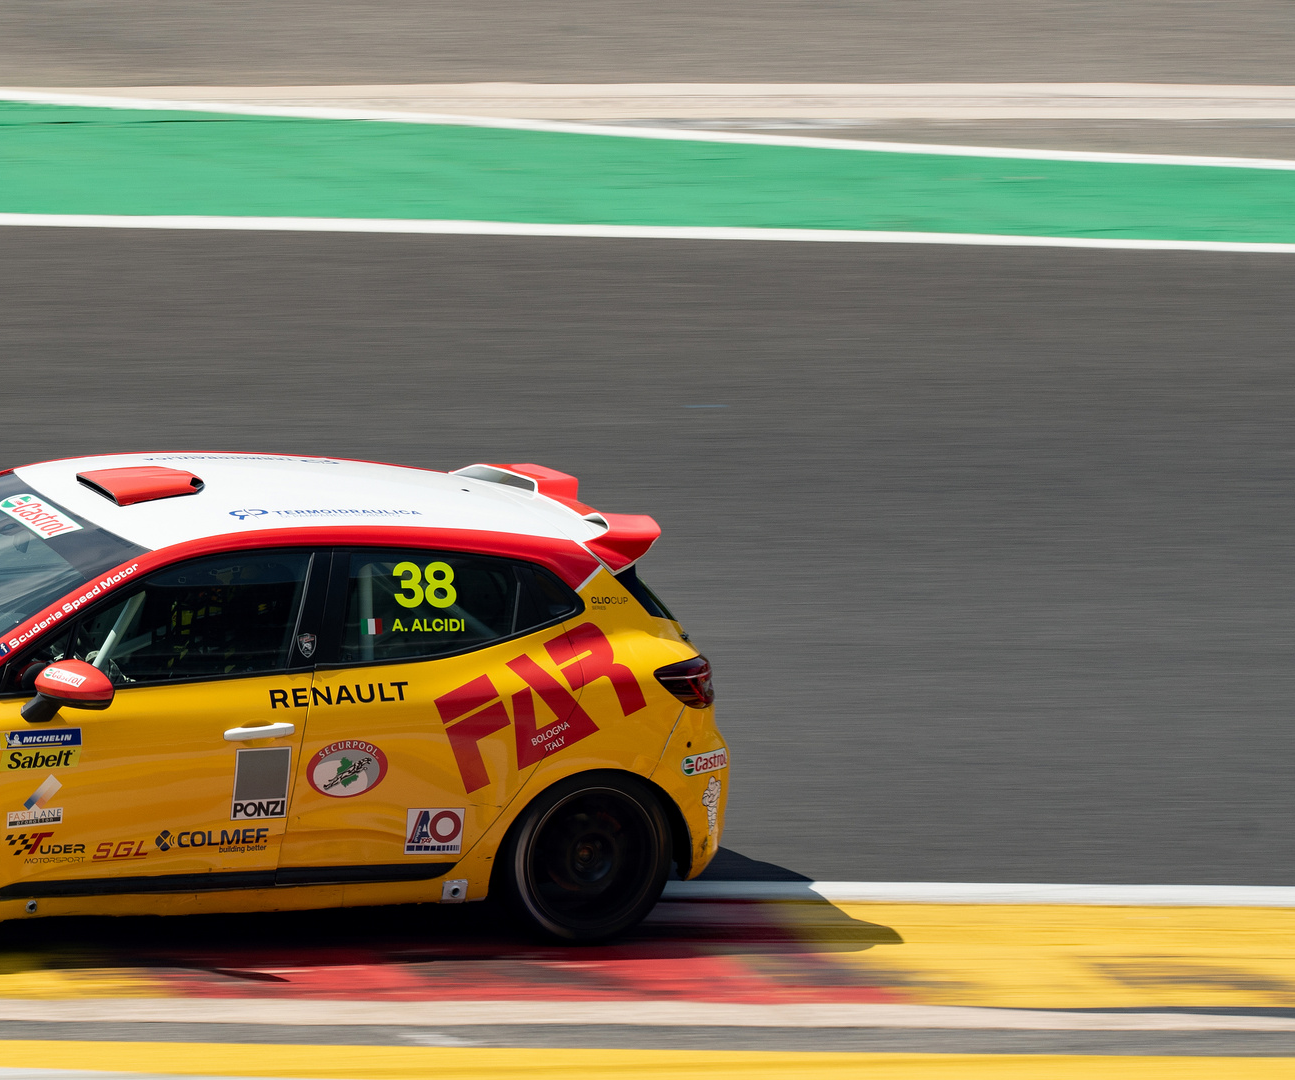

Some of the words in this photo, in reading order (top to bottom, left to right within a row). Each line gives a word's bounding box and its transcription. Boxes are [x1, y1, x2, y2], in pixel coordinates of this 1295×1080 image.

[12, 503, 74, 536] Castrol
[392, 561, 457, 609] 38
[8, 610, 63, 649] Scuderia
[61, 585, 101, 613] Speed
[100, 563, 139, 590] Motor
[391, 618, 408, 632] A.
[411, 618, 465, 632] ALCIDI
[51, 670, 83, 686] Castrol
[268, 681, 409, 709] RENAULT
[433, 621, 647, 795] FAR
[22, 733, 73, 744] MICHELIN
[530, 721, 571, 747] BOLOGNA
[544, 736, 566, 751] ITALY
[7, 749, 75, 770] Sabelt
[318, 740, 379, 759] SECURPOOL
[695, 750, 727, 772] Castrol
[232, 799, 285, 819] PONZI
[92, 840, 149, 860] SGL
[218, 846, 245, 854] building
[23, 856, 86, 865] MOTORSPORT
